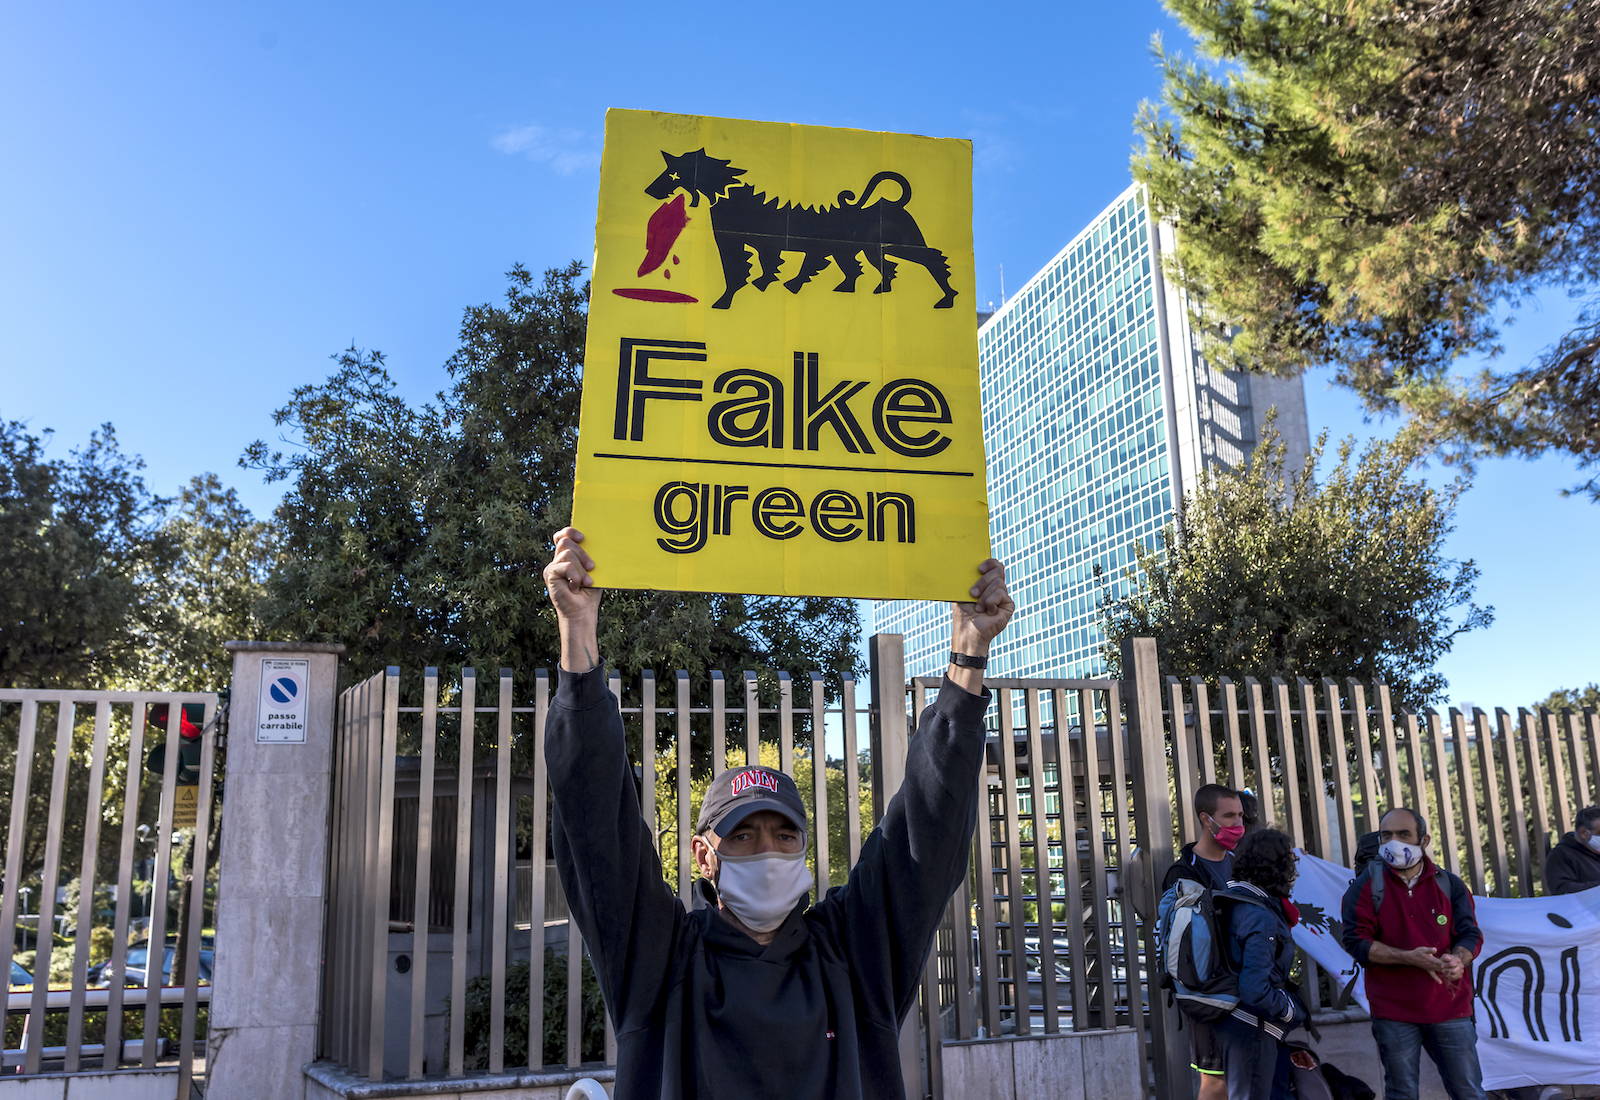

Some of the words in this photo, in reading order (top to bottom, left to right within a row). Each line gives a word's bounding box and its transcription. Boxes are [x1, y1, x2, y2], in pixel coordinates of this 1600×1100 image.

[613, 337, 953, 458] Fake
[653, 480, 916, 554] green
[731, 769, 779, 797] UNLV
